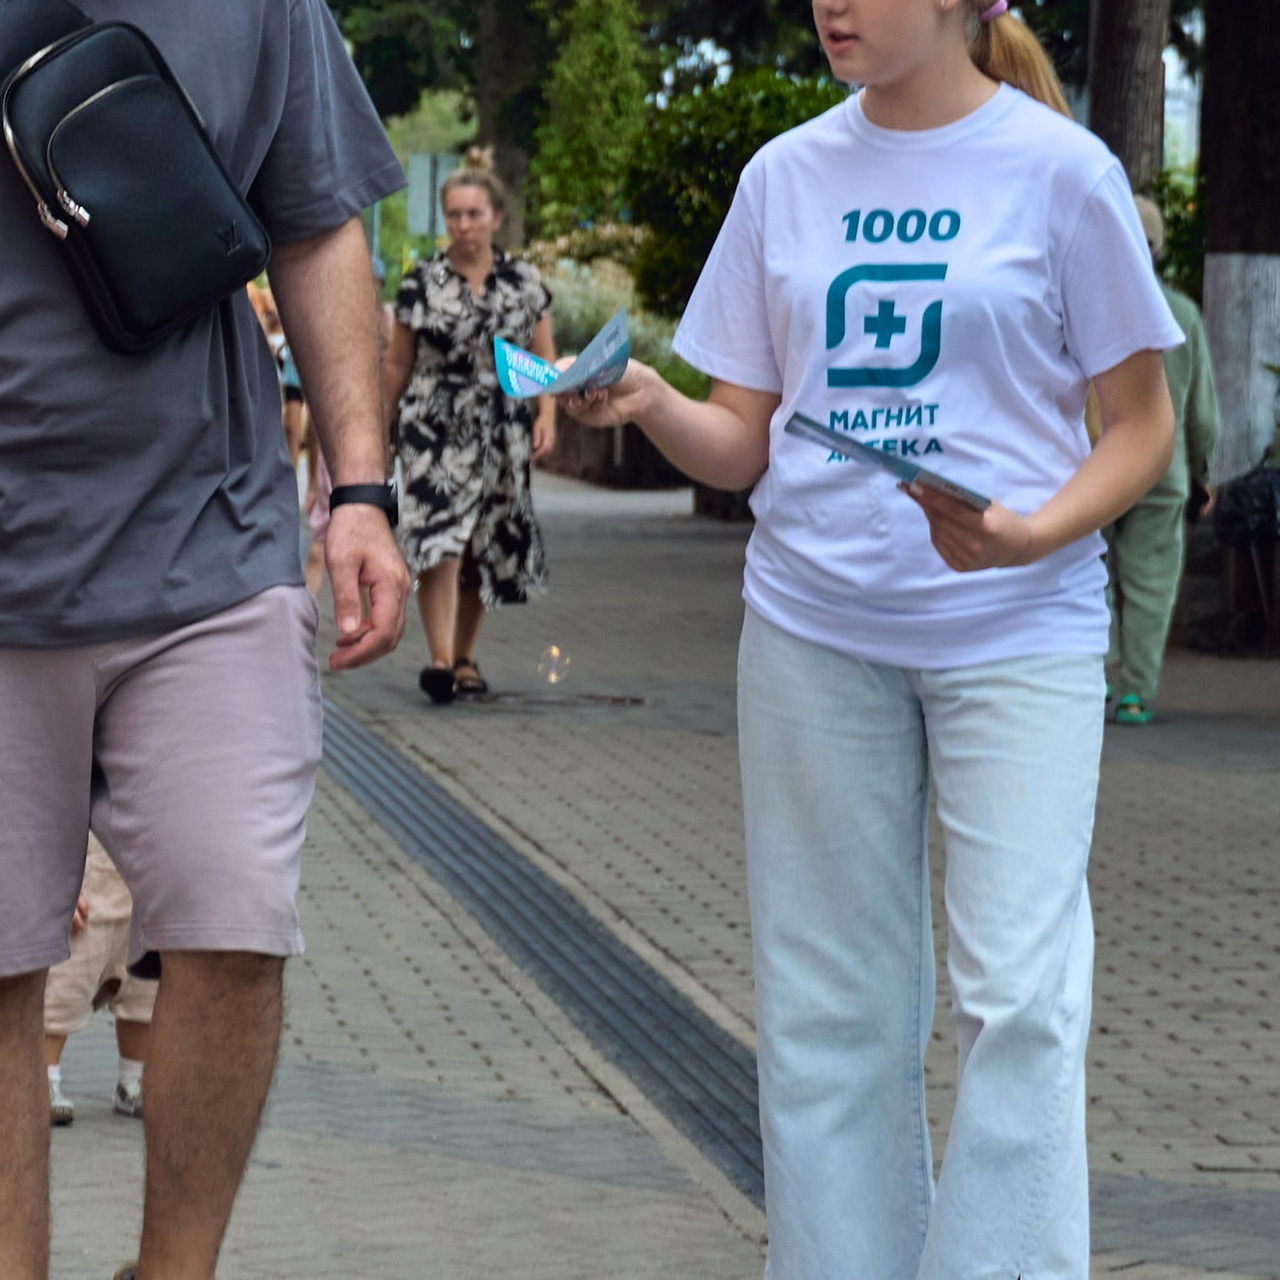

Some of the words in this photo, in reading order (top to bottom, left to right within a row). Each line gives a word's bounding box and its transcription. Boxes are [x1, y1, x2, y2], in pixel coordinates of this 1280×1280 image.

[841, 208, 961, 244] 1000
[829, 404, 939, 431] МАГНИТ
[826, 438, 943, 463] АТЕКА
